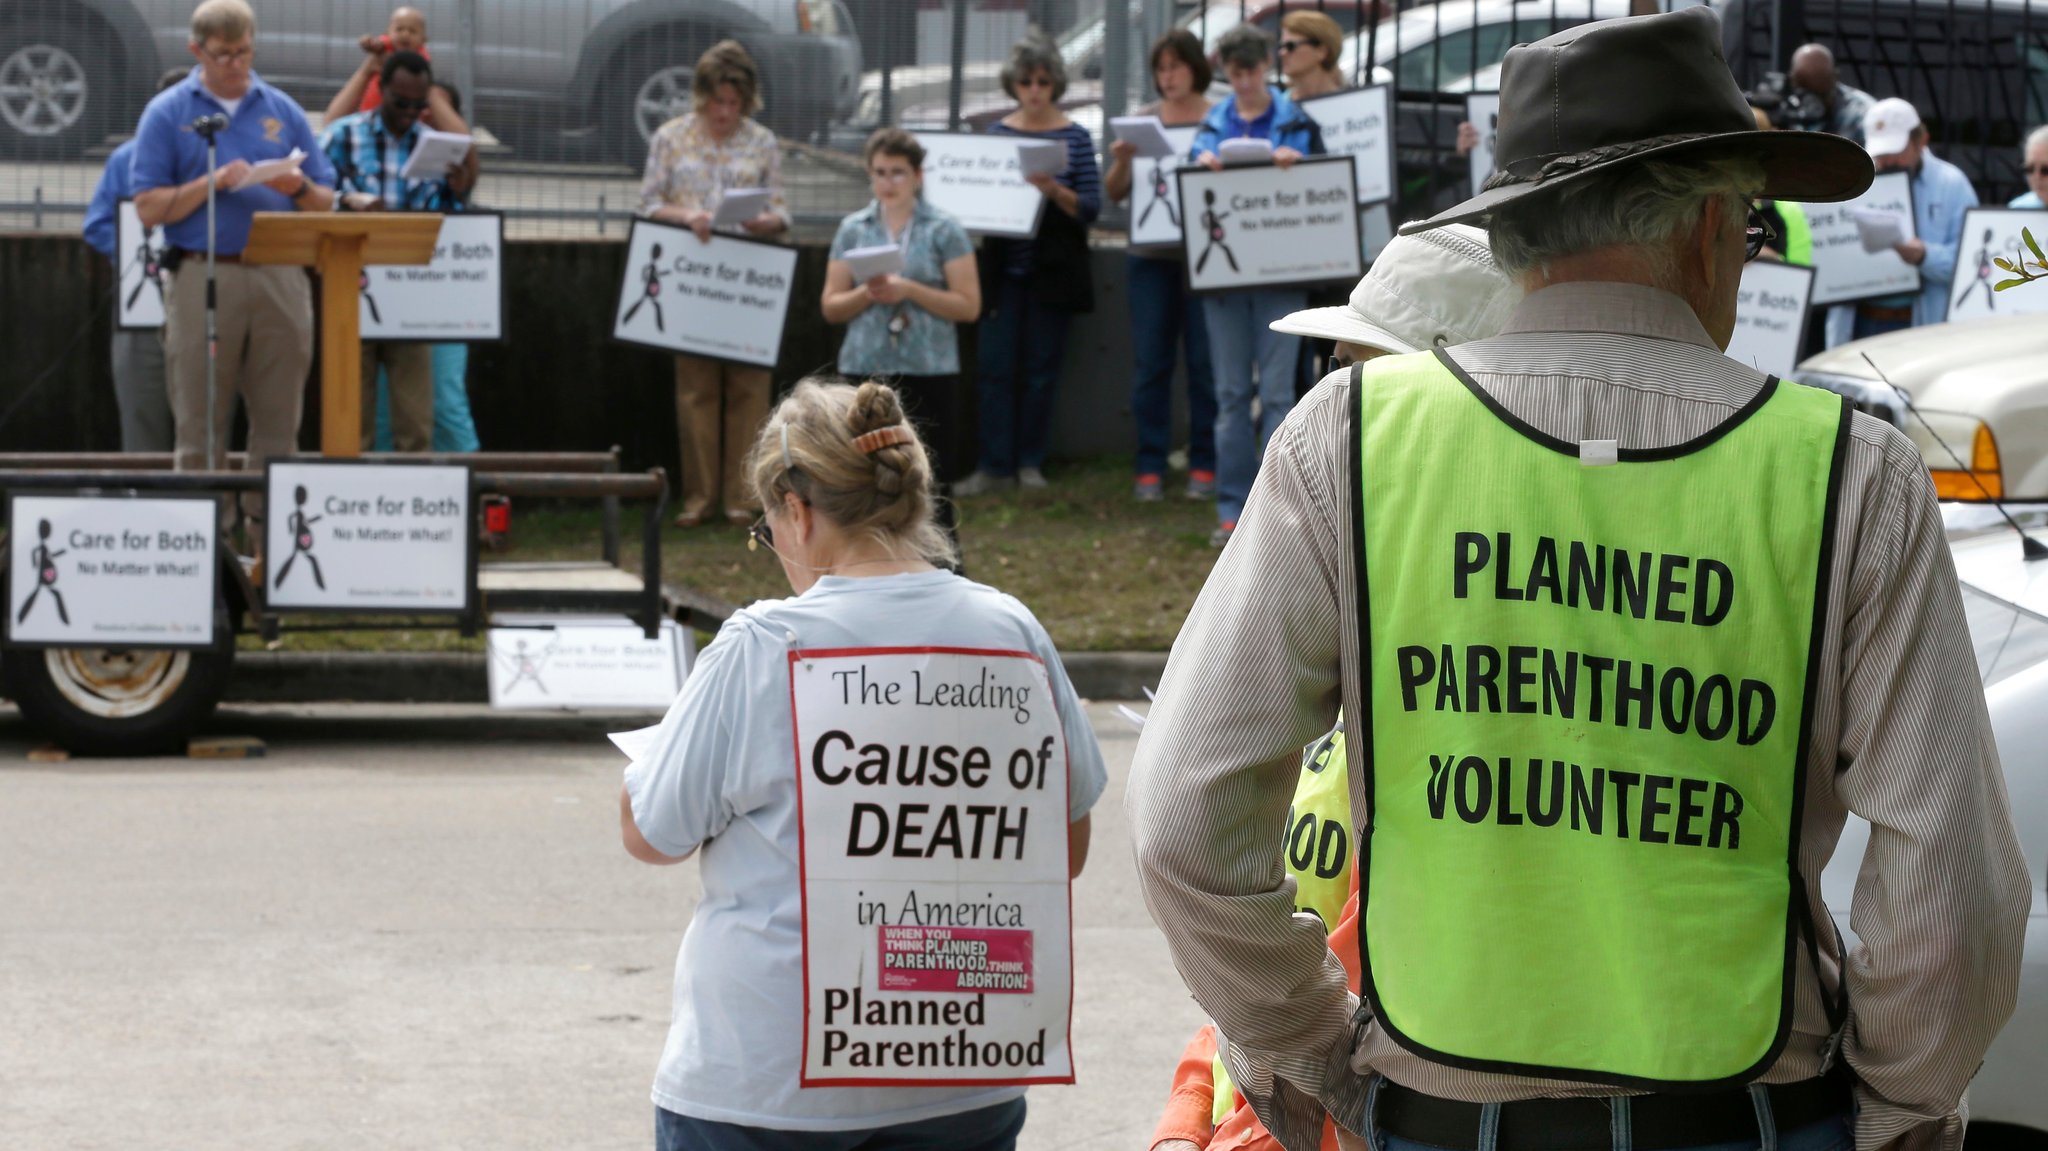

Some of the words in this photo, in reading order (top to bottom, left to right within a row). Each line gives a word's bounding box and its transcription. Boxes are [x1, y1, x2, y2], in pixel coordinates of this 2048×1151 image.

[1230, 191, 1271, 212] Care
[1274, 189, 1302, 207] for
[1305, 184, 1349, 204] Both
[450, 242, 495, 260] Both
[674, 256, 713, 278] Care
[716, 262, 741, 282] for
[744, 266, 787, 291] Both
[1758, 290, 1800, 311] Both
[324, 496, 370, 516] Care
[376, 495, 405, 516] for
[412, 496, 460, 517] Both
[69, 529, 116, 549] Care
[121, 529, 151, 550] for
[158, 530, 207, 551] Both
[333, 528, 354, 540] No
[358, 528, 403, 541] Matter
[408, 528, 453, 542] What!
[77, 561, 98, 575] No
[102, 562, 150, 575] Matter
[154, 562, 200, 576] What!
[1453, 531, 1735, 627] PLANNED
[832, 665, 901, 705] The
[912, 666, 1031, 724] Leading
[1396, 643, 1777, 747] PARENTHOOD
[812, 730, 991, 789] Cause
[1008, 736, 1055, 790] of
[1426, 754, 1744, 850] VOLUNTEER
[846, 803, 1029, 860] DEATH
[857, 891, 889, 925] in
[897, 890, 1024, 927] America
[885, 928, 923, 940] WHEN
[925, 929, 952, 941] YOU
[885, 940, 925, 952] THINK
[925, 939, 988, 956] PLANNED
[989, 961, 1023, 972] THINK
[957, 972, 1028, 990] ABORTION!
[824, 986, 985, 1026] Planned
[822, 1028, 1046, 1067] Parenthood
